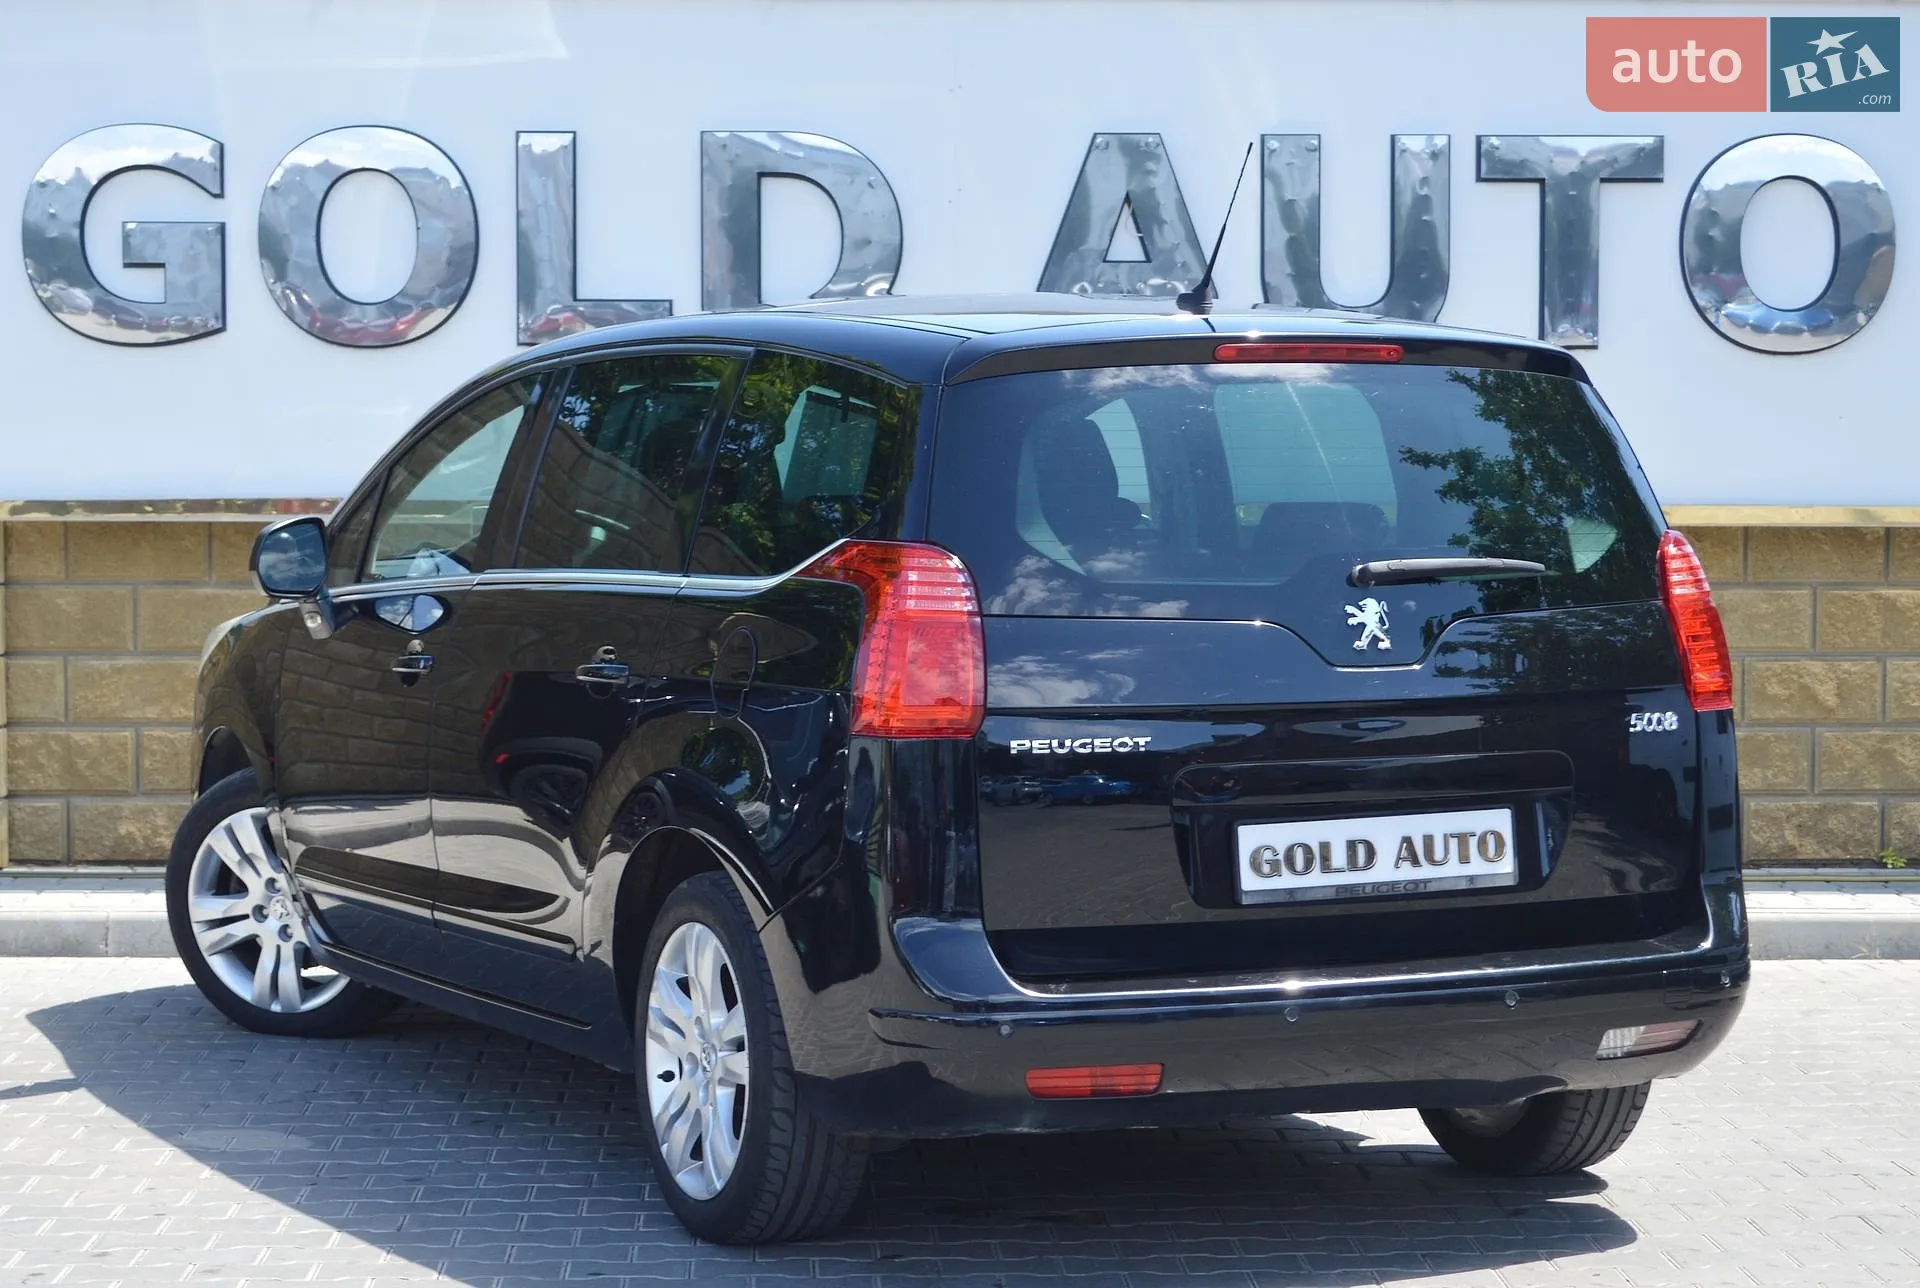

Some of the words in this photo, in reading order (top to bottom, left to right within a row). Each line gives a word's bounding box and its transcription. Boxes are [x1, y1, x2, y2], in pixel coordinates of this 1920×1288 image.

[22, 123, 903, 347] GOLD
[1037, 132, 1897, 356] AUTO
[1629, 711, 1679, 732] 5008
[1009, 736, 1152, 754] PEUGEOT
[1249, 839, 1378, 878] GOLD
[1394, 830, 1507, 868] AUTO
[1335, 880, 1432, 897] PEUGEOT
